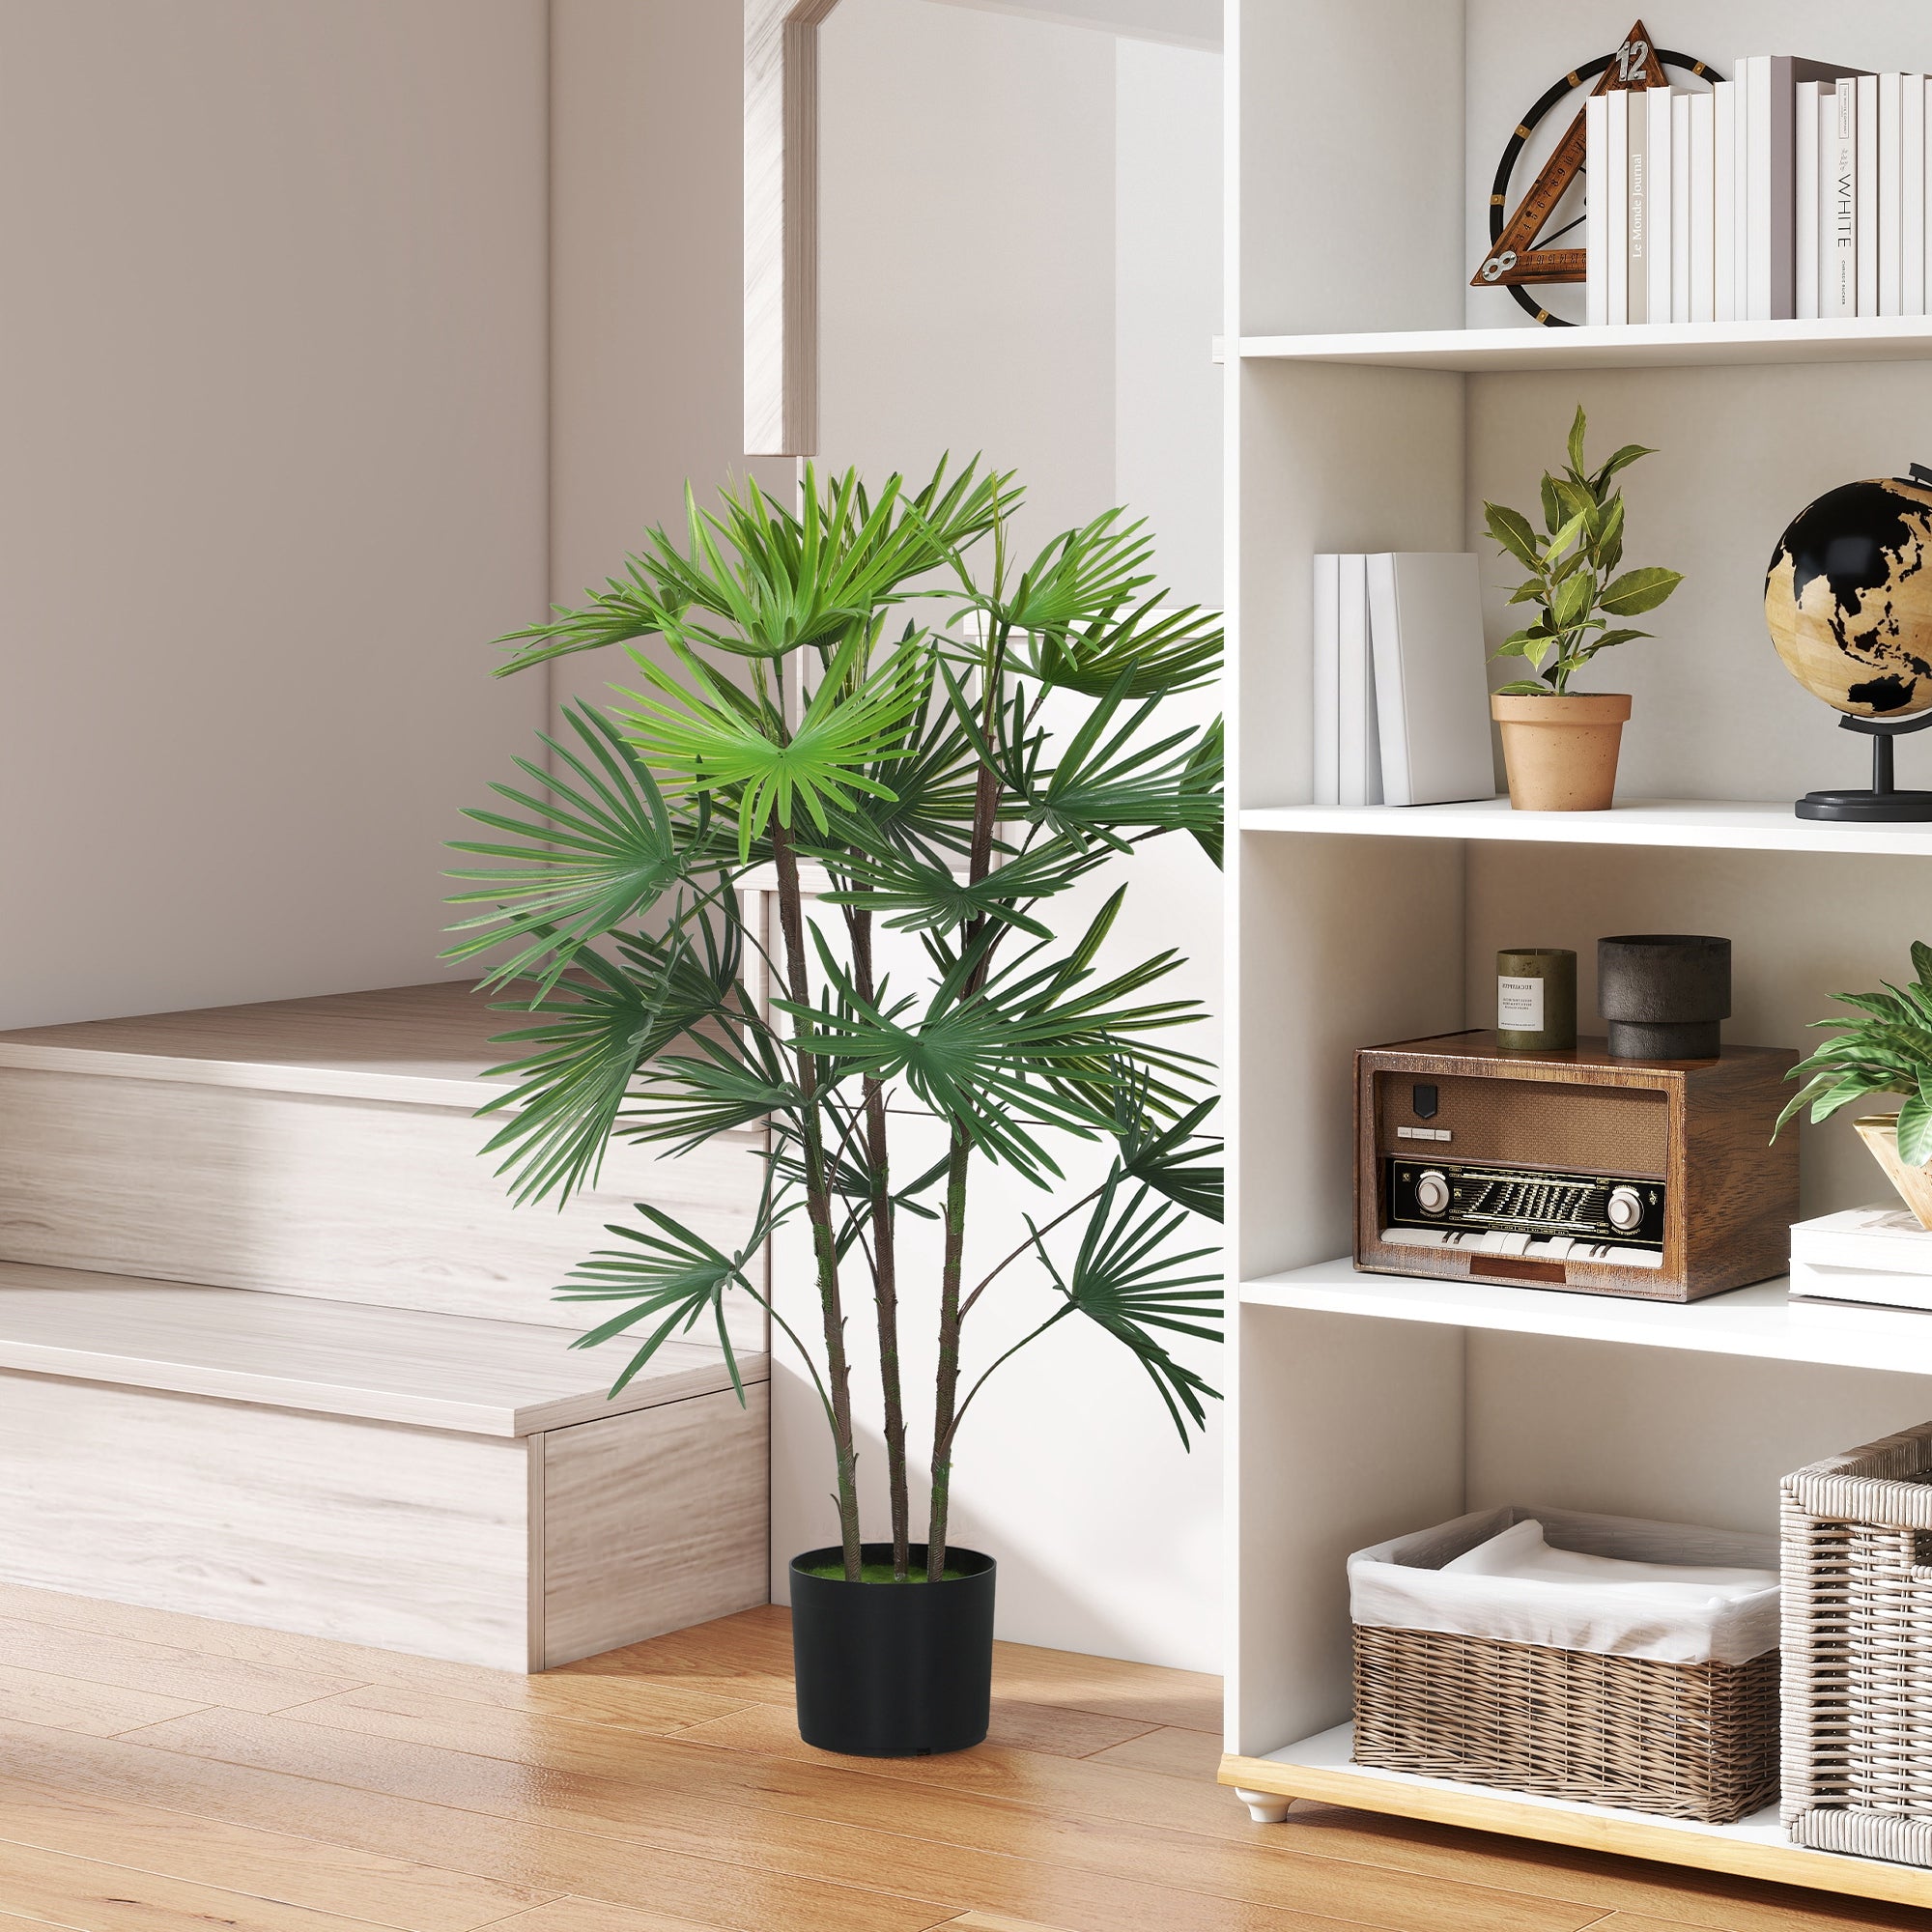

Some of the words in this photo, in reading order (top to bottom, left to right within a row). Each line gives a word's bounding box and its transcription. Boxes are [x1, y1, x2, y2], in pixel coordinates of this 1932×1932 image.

[1615, 40, 1649, 82] 12
[1632, 154, 1643, 197] Journal
[1632, 200, 1642, 241] Monde
[1837, 174, 1852, 247] WHITE
[1482, 251, 1518, 282] 8
[1633, 243, 1642, 258] Le
